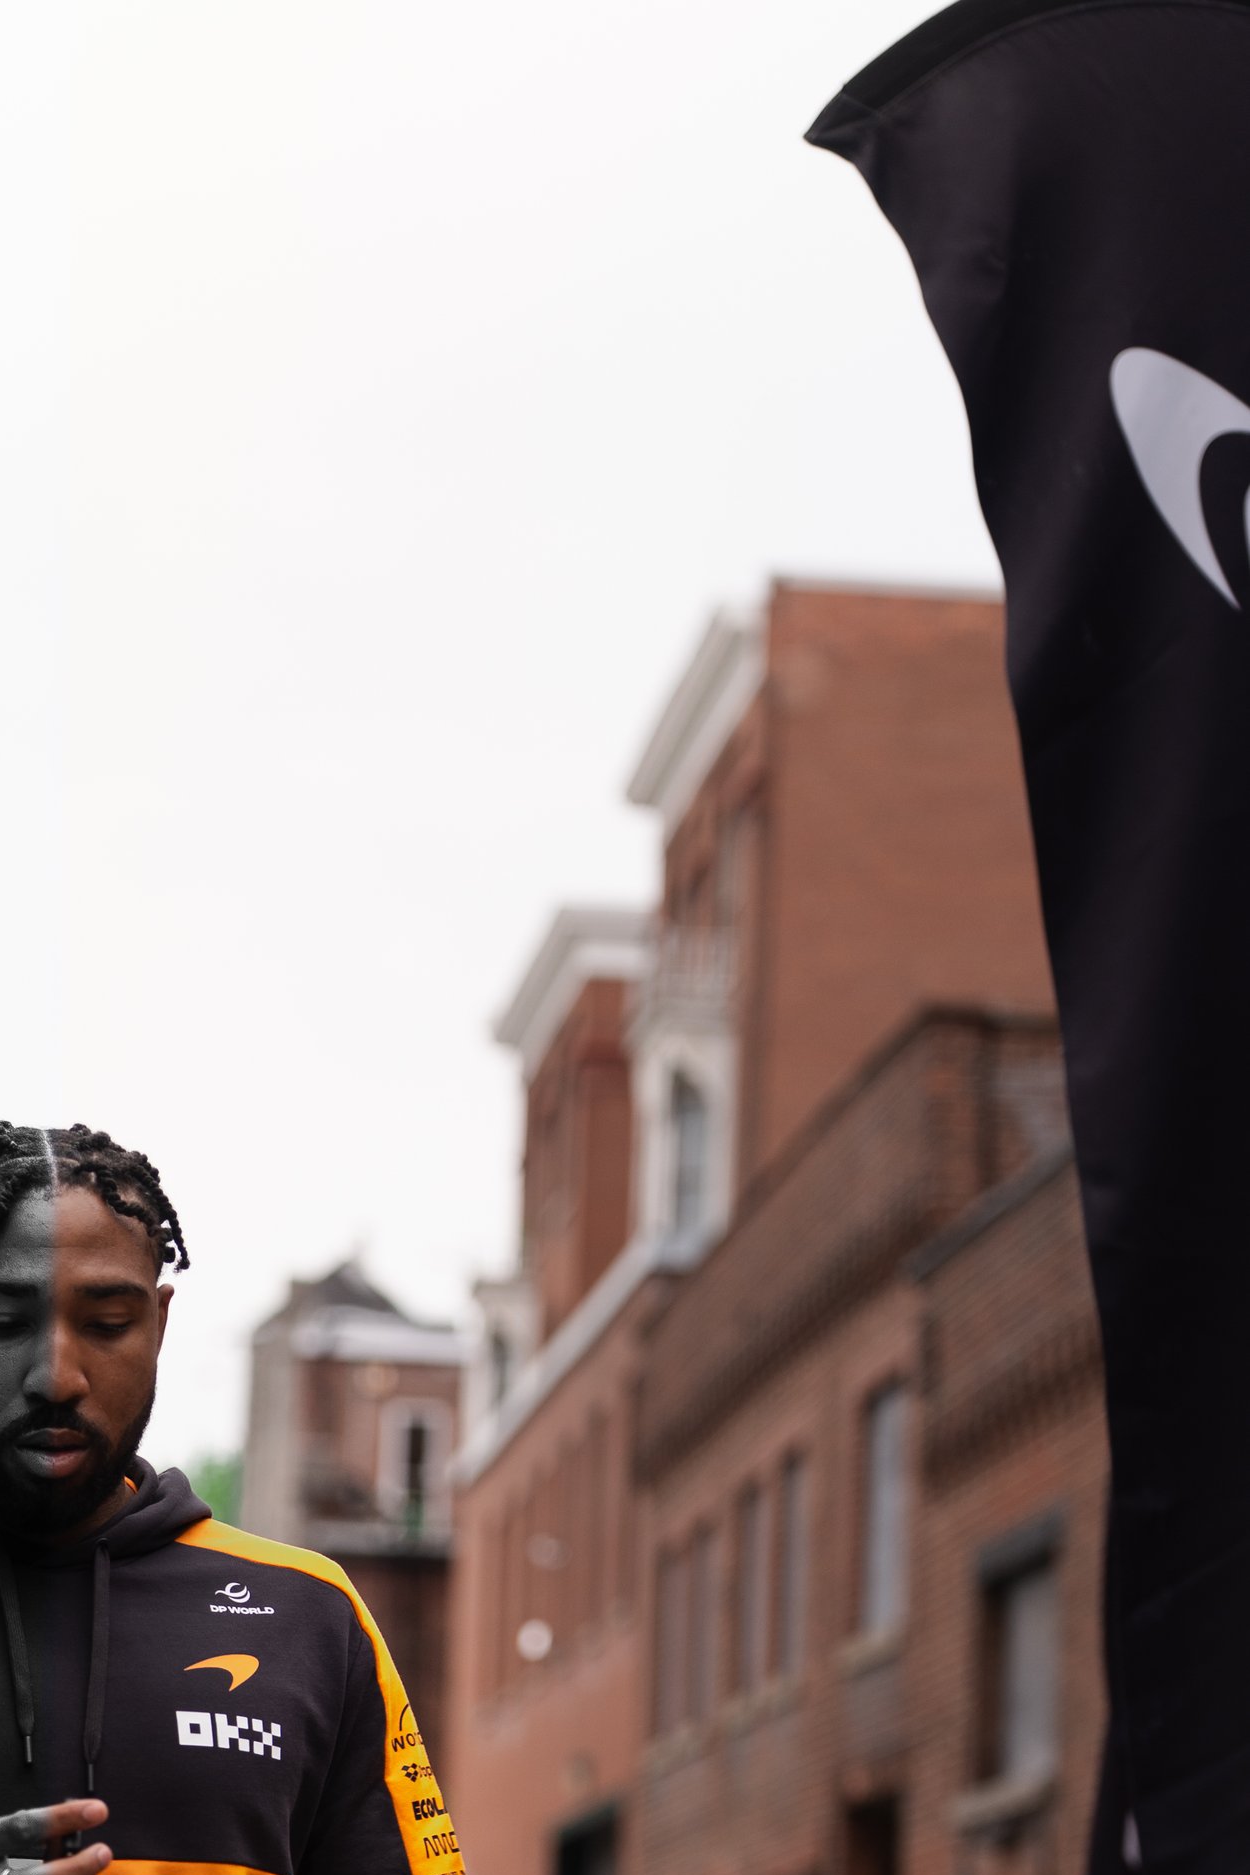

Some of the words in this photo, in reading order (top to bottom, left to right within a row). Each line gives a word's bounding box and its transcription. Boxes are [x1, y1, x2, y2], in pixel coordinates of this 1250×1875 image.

[209, 1604, 226, 1613] DP
[227, 1605, 275, 1615] WORLD
[176, 1710, 281, 1760] OKX
[412, 1797, 448, 1821] ECOL
